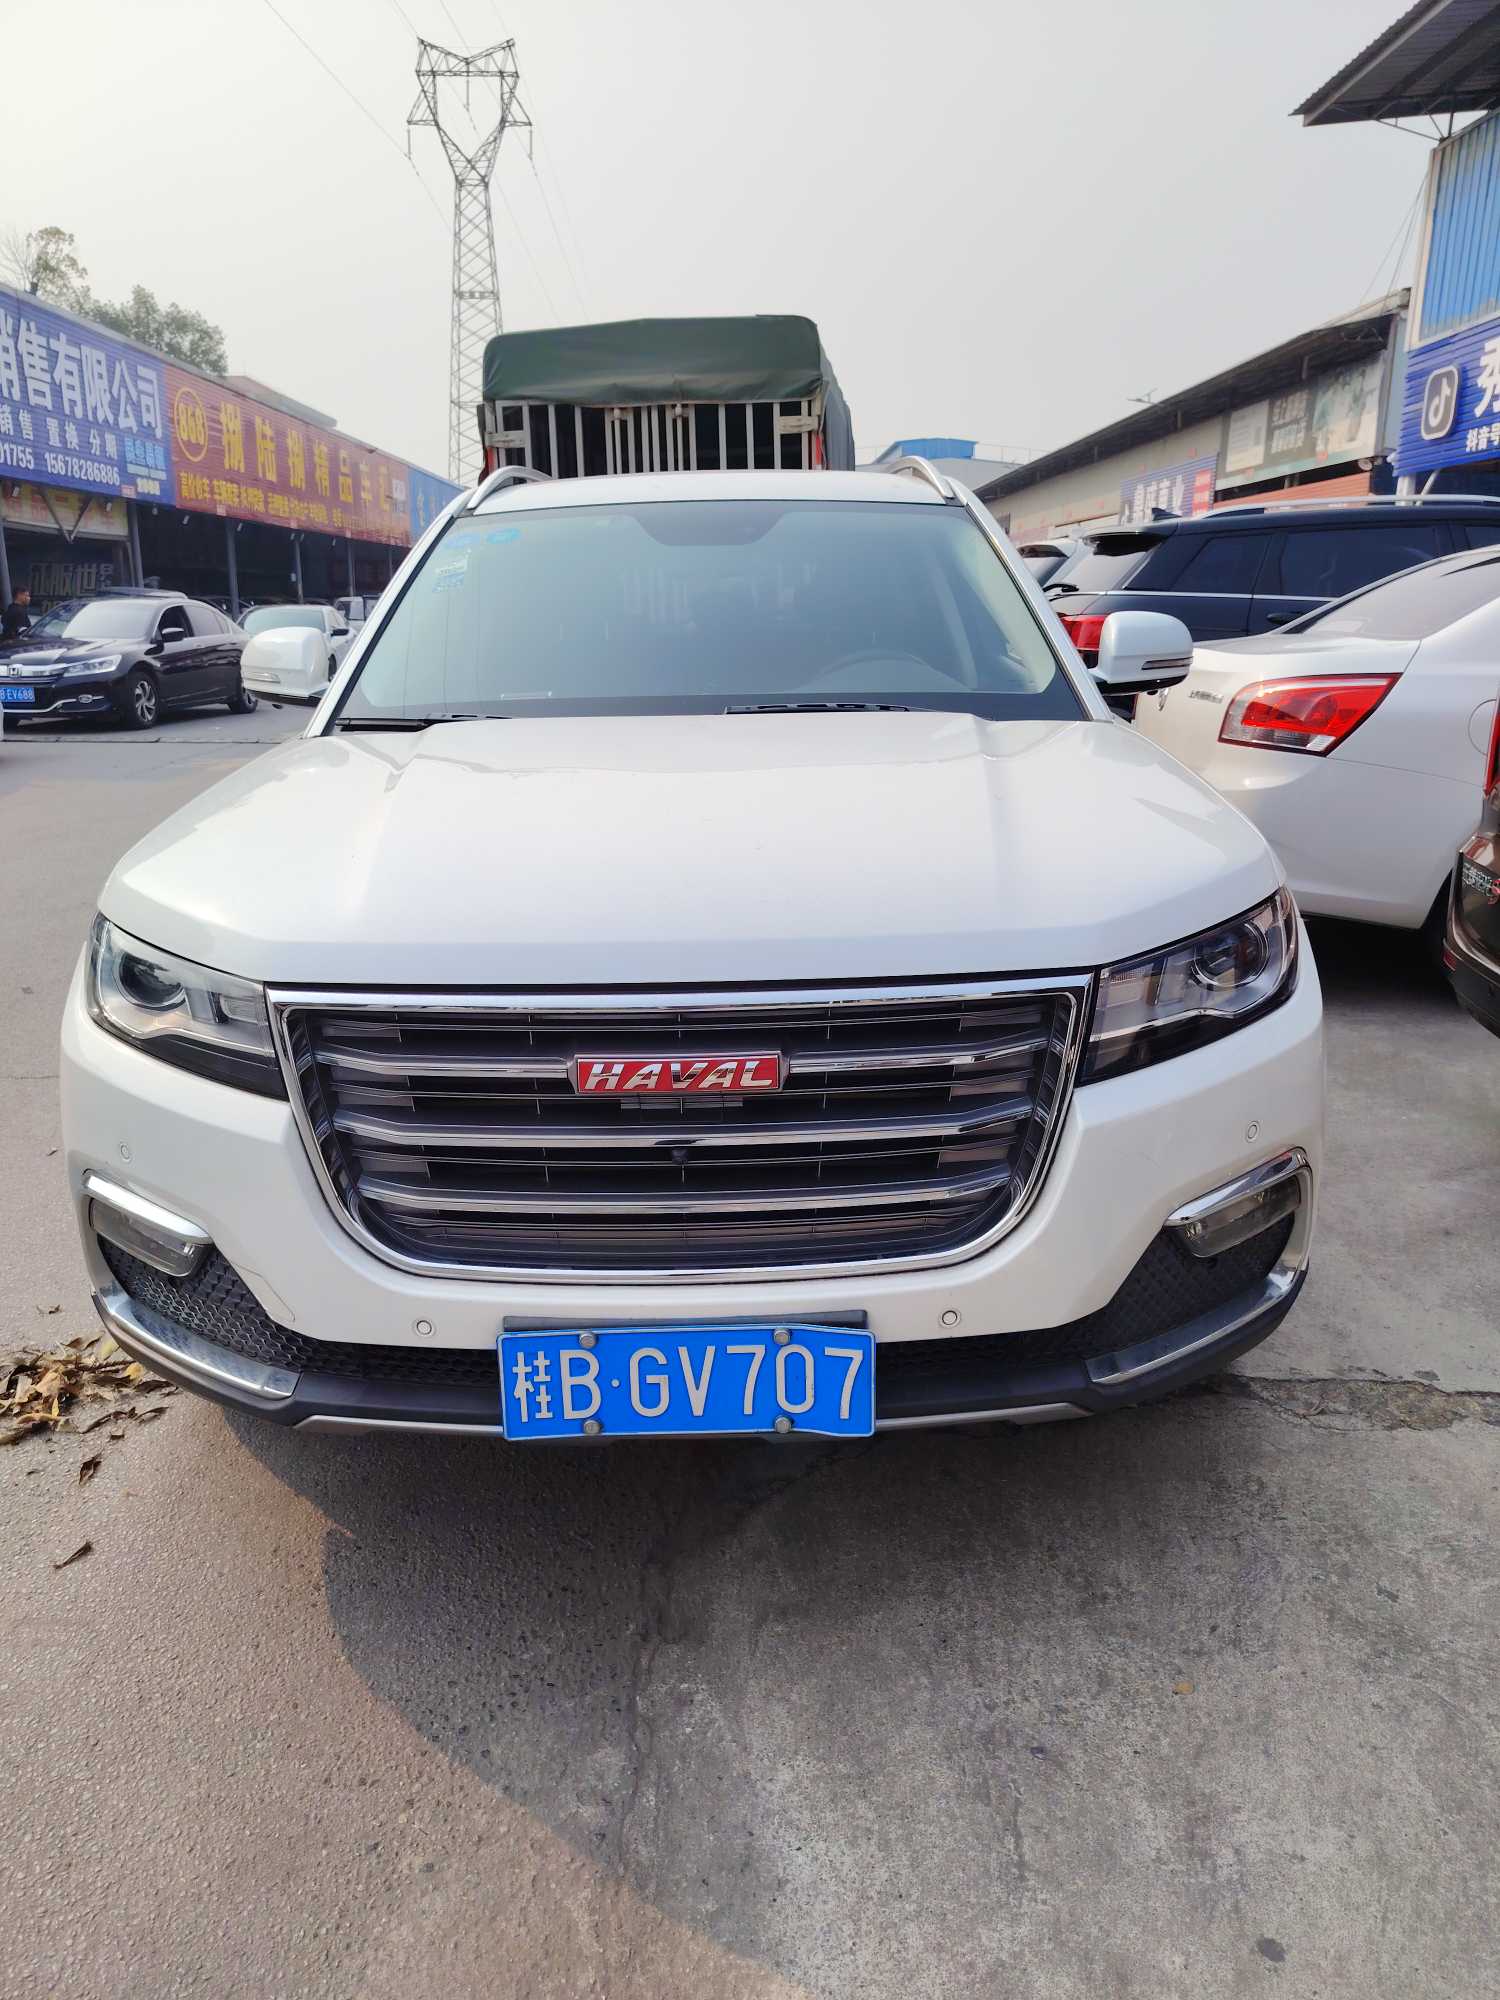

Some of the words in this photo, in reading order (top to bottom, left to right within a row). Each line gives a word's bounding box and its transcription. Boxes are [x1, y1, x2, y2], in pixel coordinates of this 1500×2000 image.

[46, 416, 79, 451] 置换
[89, 428, 118, 460] 分期
[1465, 422, 1500, 452] 抖音号
[44, 451, 120, 486] 15678286886
[584, 1061, 773, 1090] HAVAL
[512, 1343, 864, 1423] 桂B·GV707
